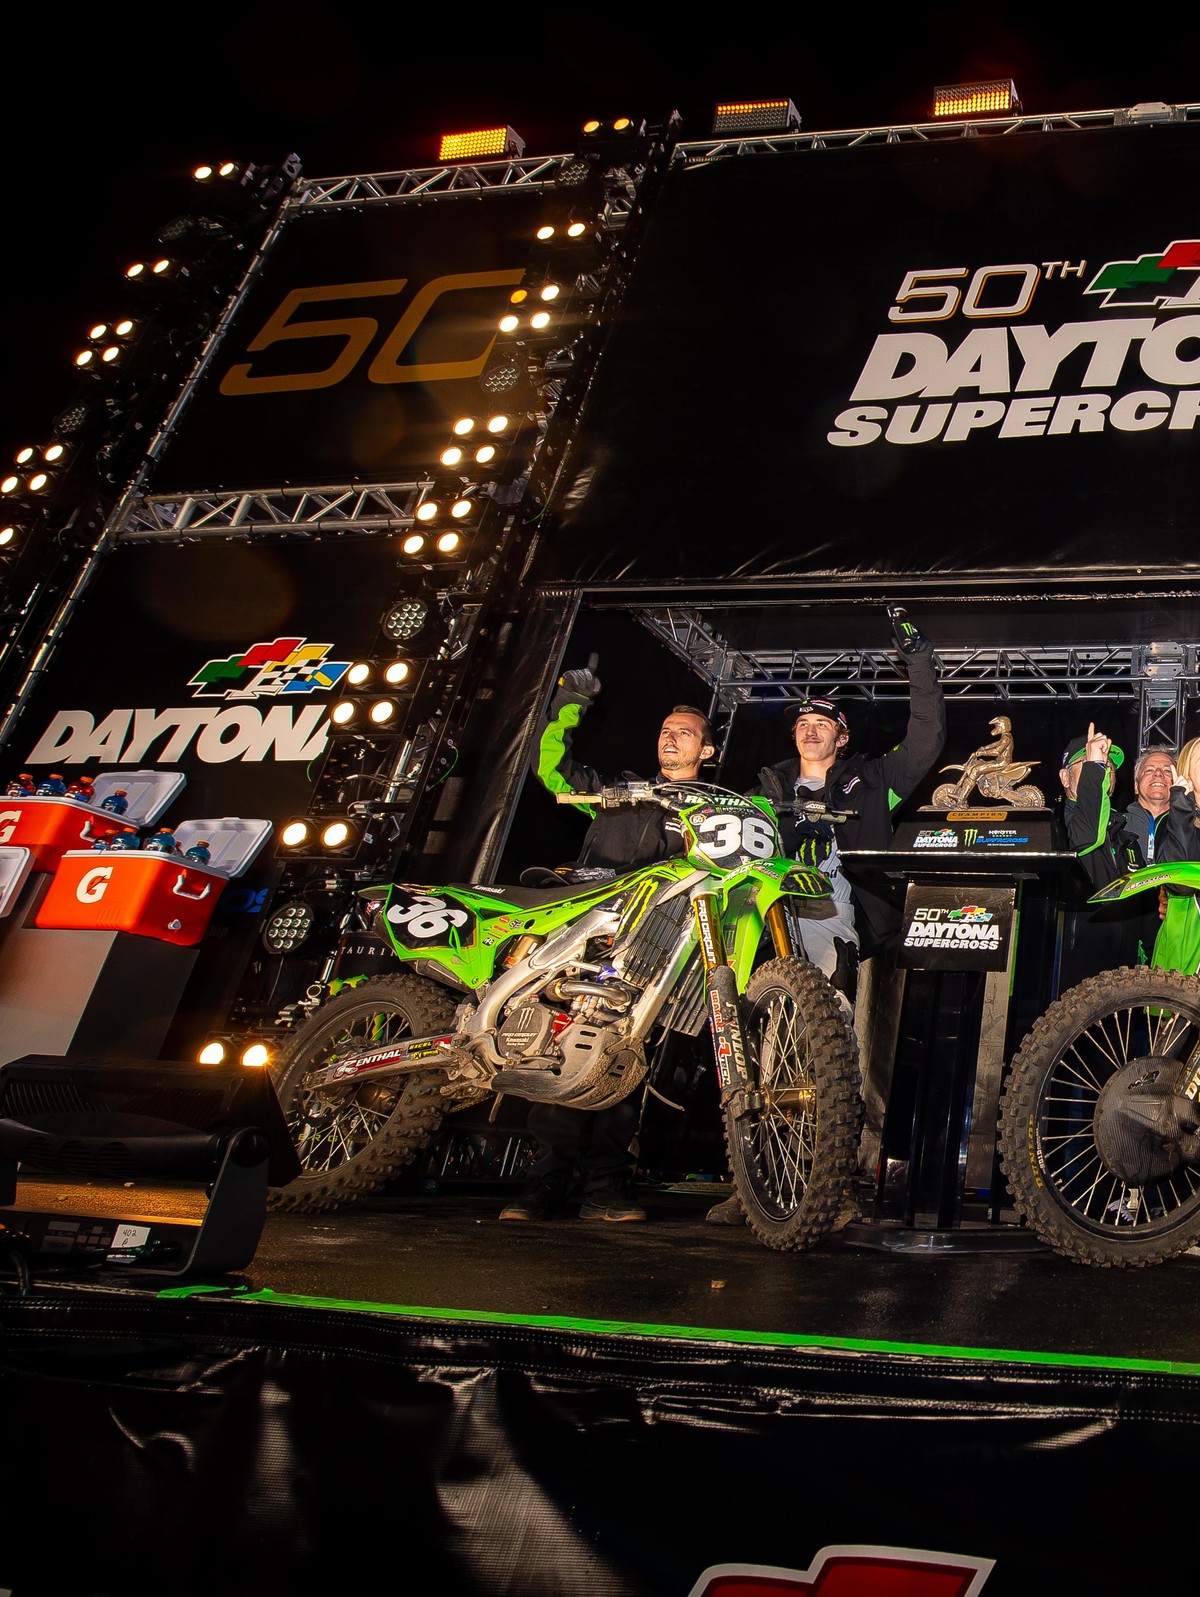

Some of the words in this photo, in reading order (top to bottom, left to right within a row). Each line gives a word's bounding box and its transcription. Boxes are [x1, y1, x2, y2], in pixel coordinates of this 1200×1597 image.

[699, 813, 775, 858] 36
[915, 836, 959, 844] DAYTONA
[76, 866, 114, 904] G
[472, 884, 506, 894] Kawasaki
[387, 895, 469, 938] 36
[698, 899, 708, 922] PRO
[702, 922, 717, 964] CIRCUIT
[903, 937, 999, 950] SUPERCROSS
[907, 922, 1000, 940] DAYTONA
[710, 990, 724, 1033] BRAKING
